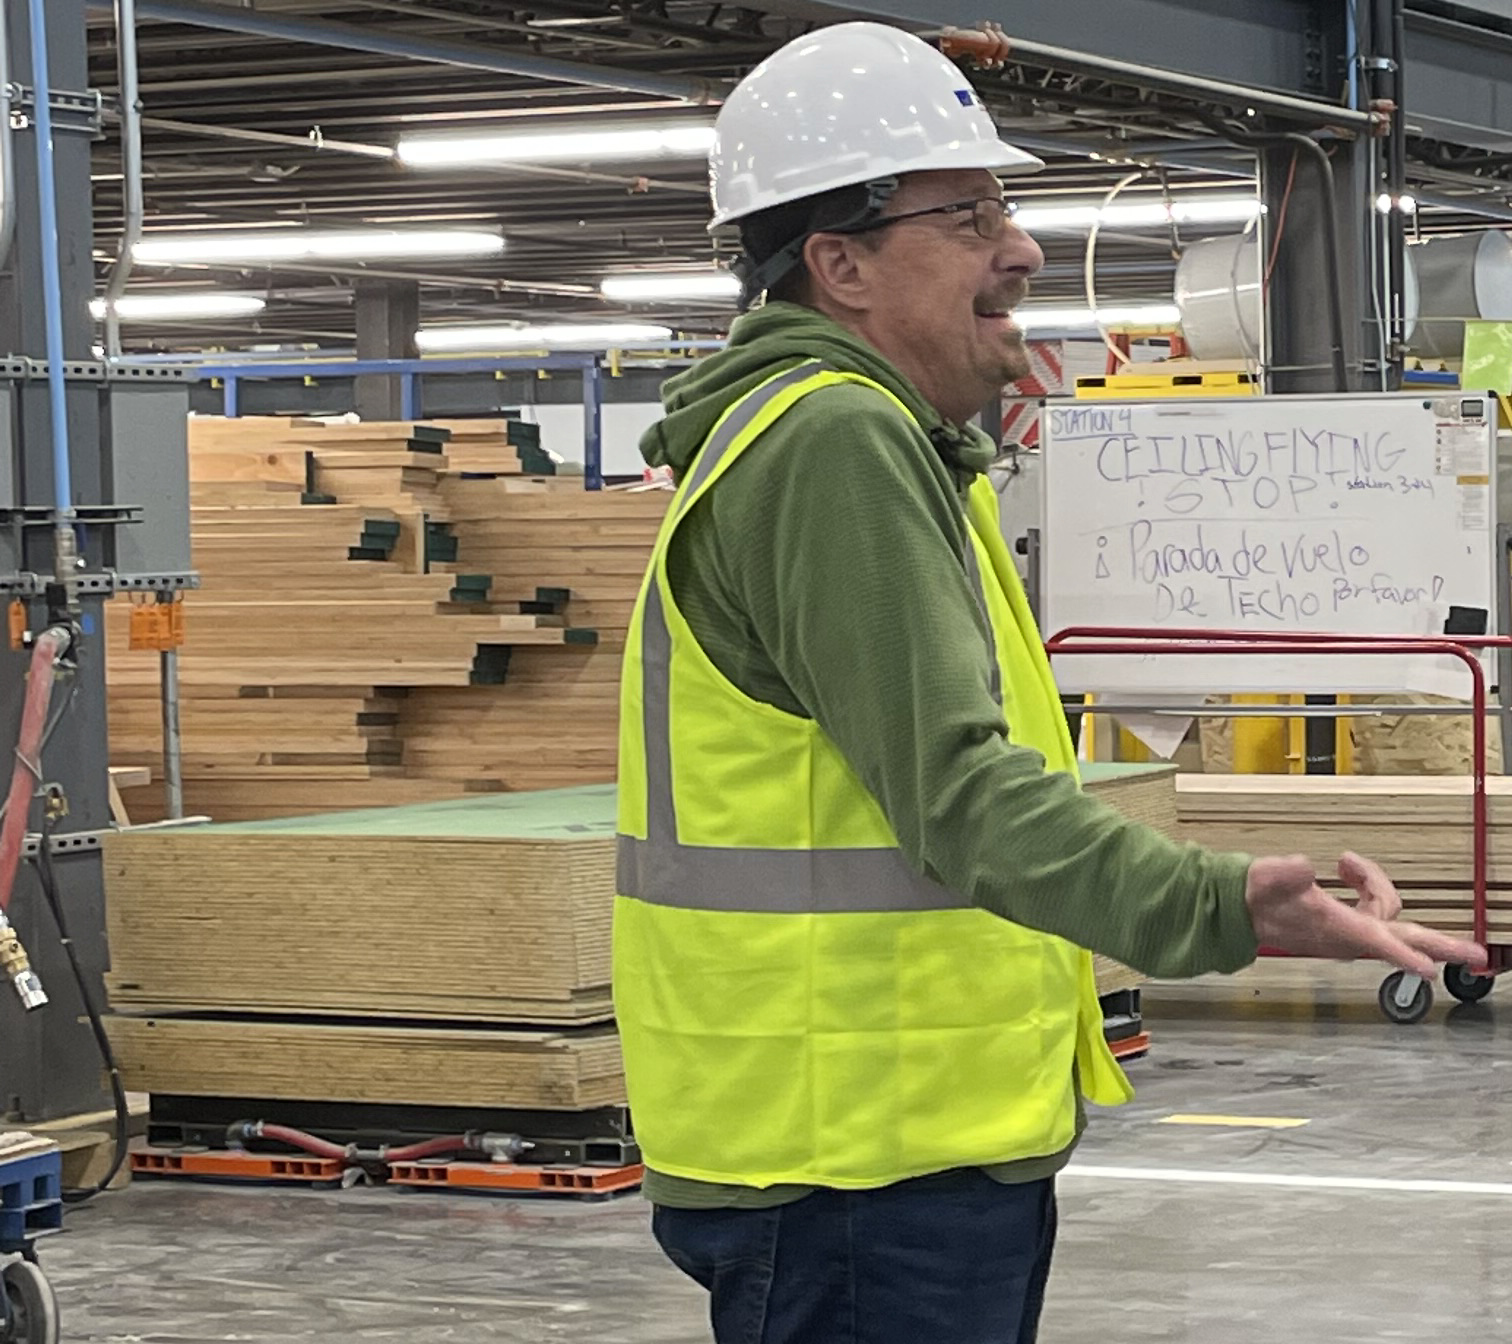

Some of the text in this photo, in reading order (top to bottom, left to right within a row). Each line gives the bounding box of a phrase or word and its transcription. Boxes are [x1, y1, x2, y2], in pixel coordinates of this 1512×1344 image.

[1119, 408, 1132, 432] 4
[1097, 429, 1259, 483] CEILING
[1164, 474, 1318, 514] STOP
[1131, 519, 1223, 584] Parada
[1233, 529, 1276, 577] de
